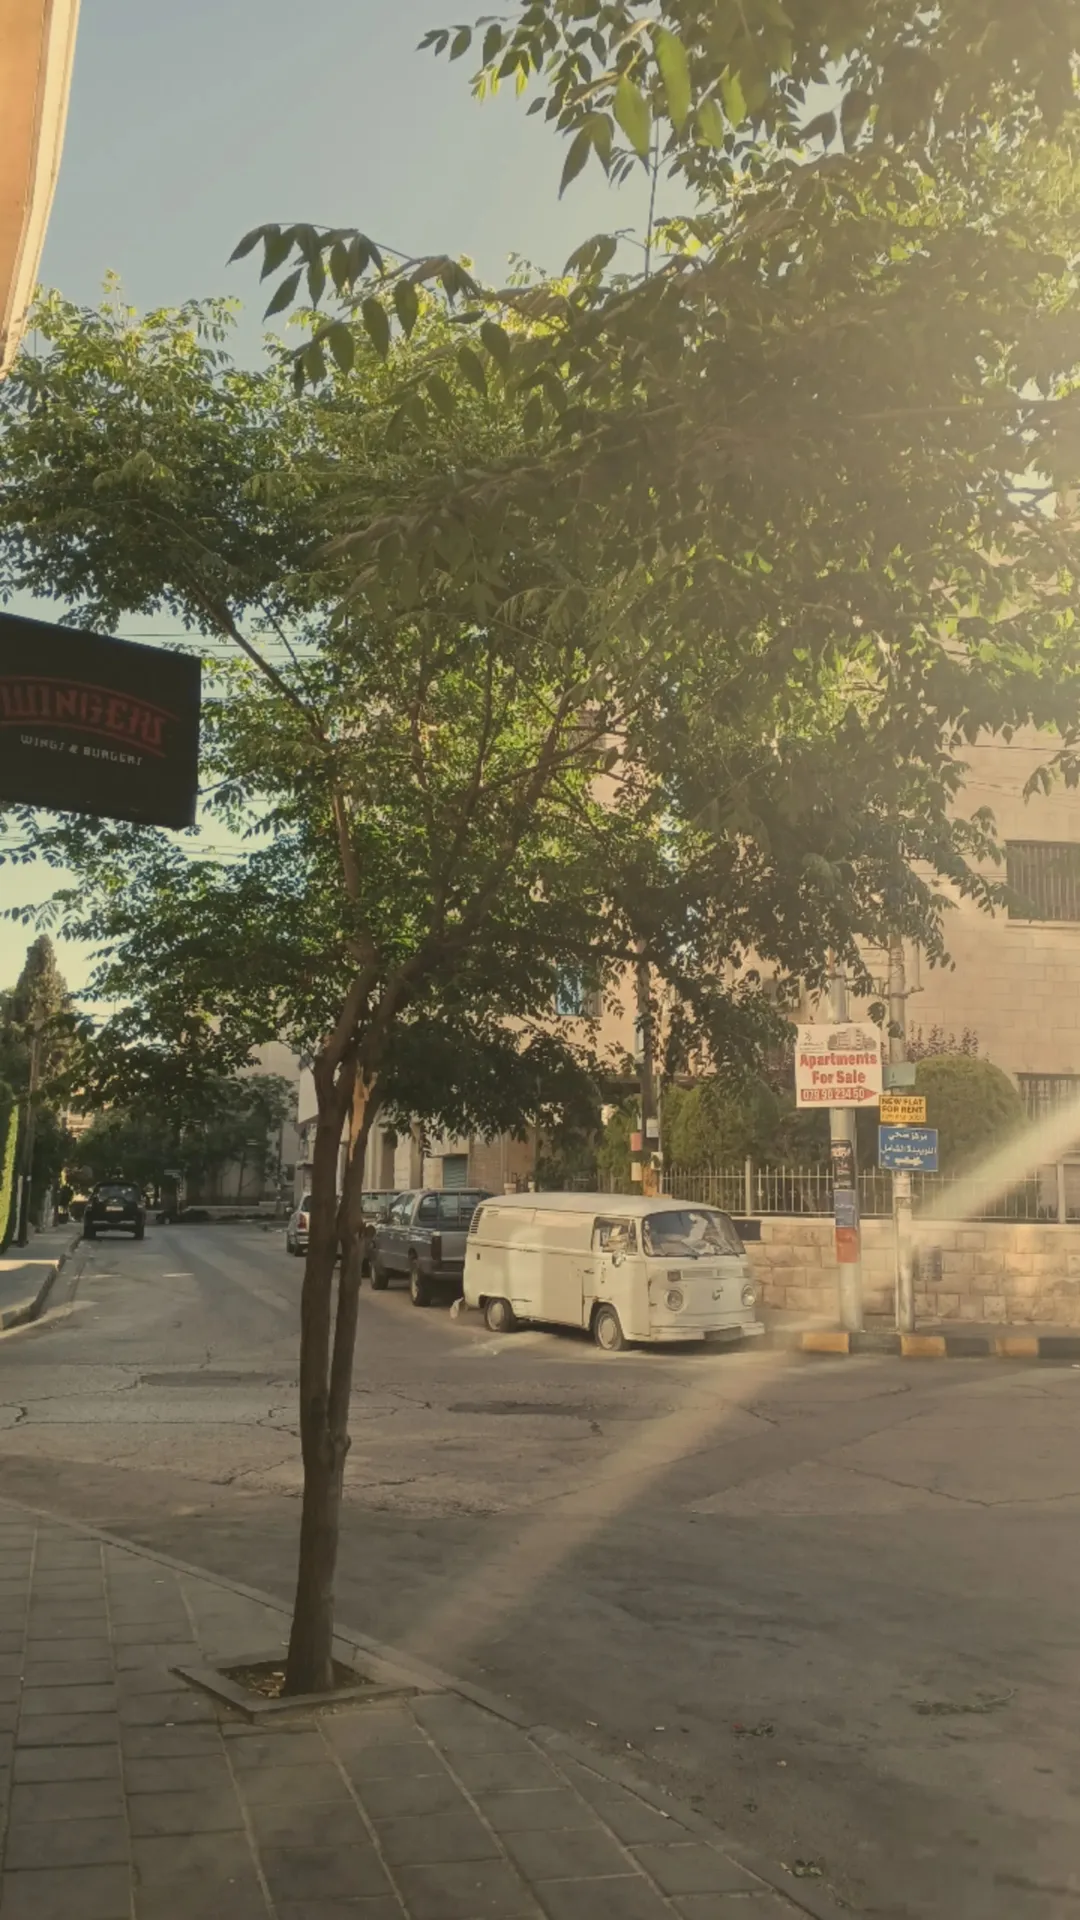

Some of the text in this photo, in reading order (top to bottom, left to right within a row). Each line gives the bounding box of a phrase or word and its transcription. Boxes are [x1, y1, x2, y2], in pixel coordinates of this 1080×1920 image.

[21, 734, 143, 766] WINGS & BURGERS
[800, 1052, 877, 1069] Apartments
[812, 1070, 866, 1085] For Sale
[881, 1105, 924, 1114] FOR RENT
[903, 1098, 924, 1106] FLAT
